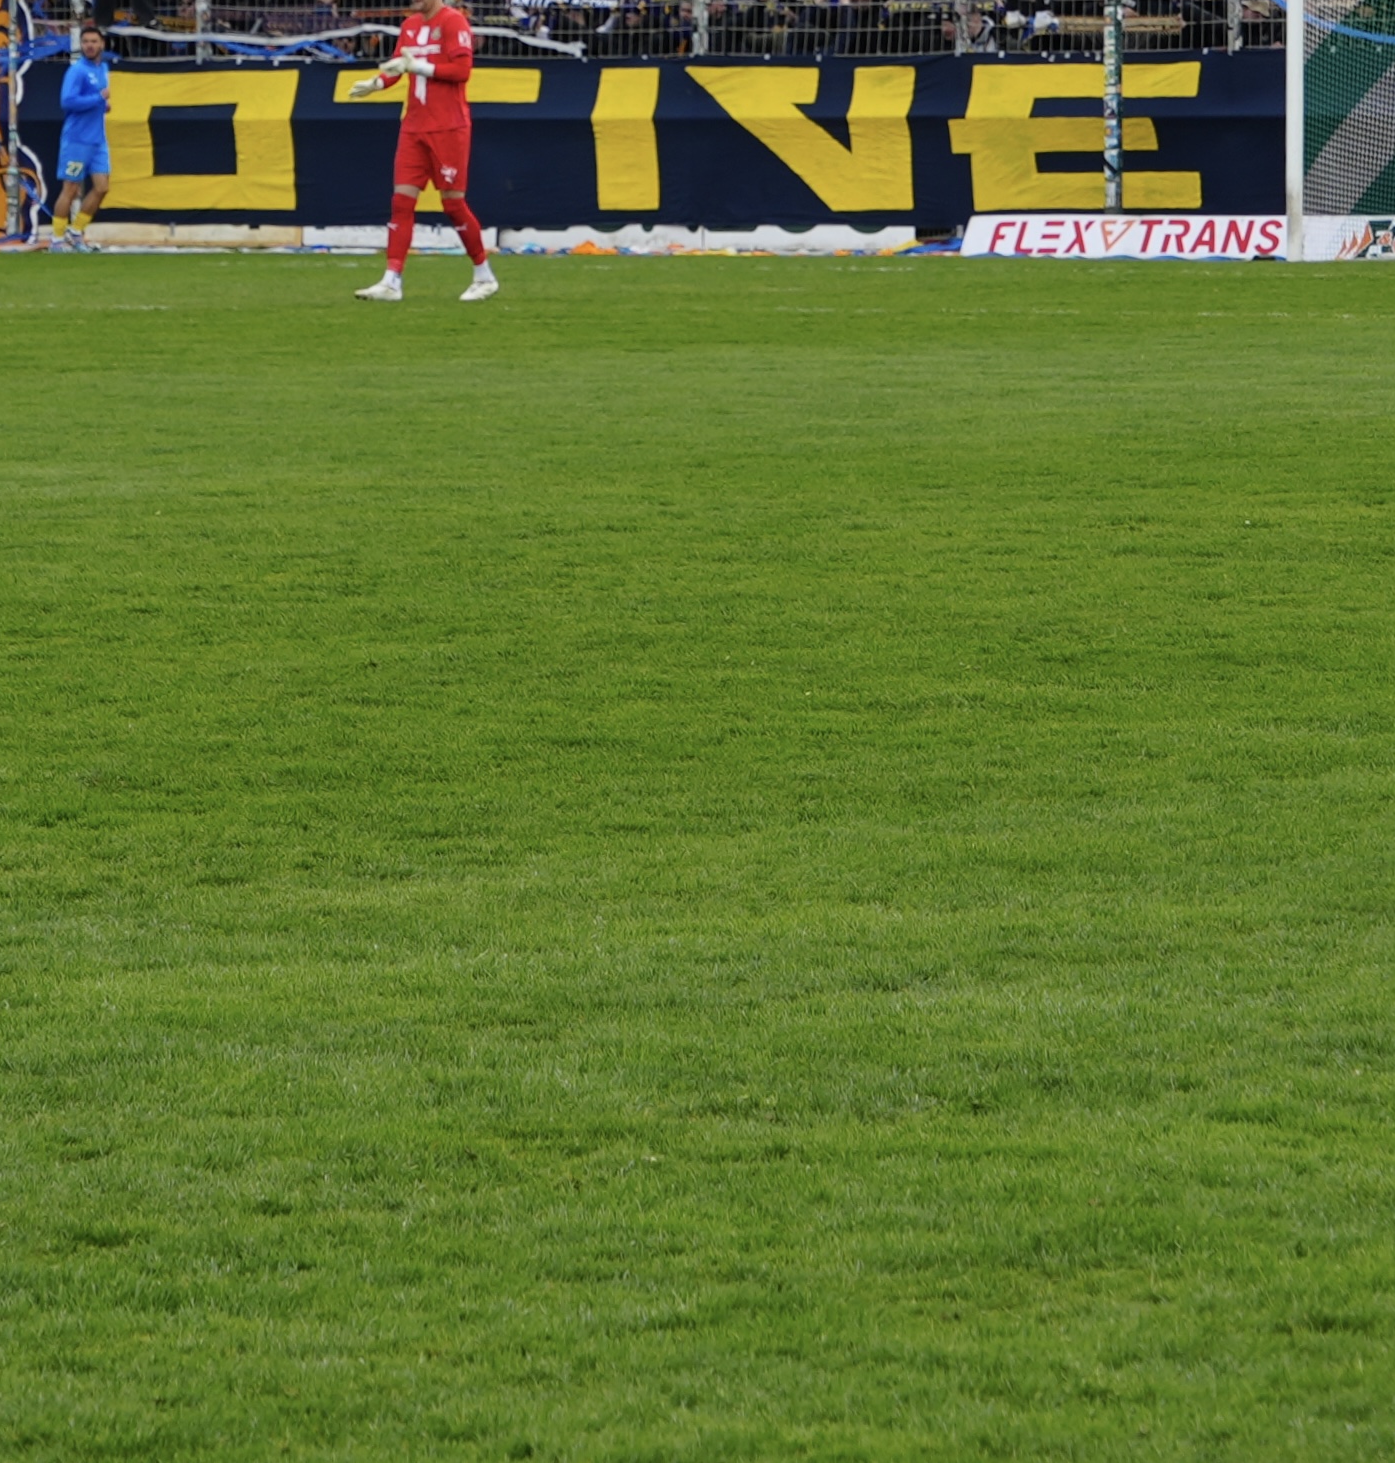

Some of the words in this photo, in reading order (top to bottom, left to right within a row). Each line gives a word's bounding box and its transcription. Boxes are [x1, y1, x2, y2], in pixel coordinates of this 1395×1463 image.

[66, 161, 85, 177] 27
[988, 220, 1095, 254] FLEX
[1140, 219, 1285, 254] TRANS
